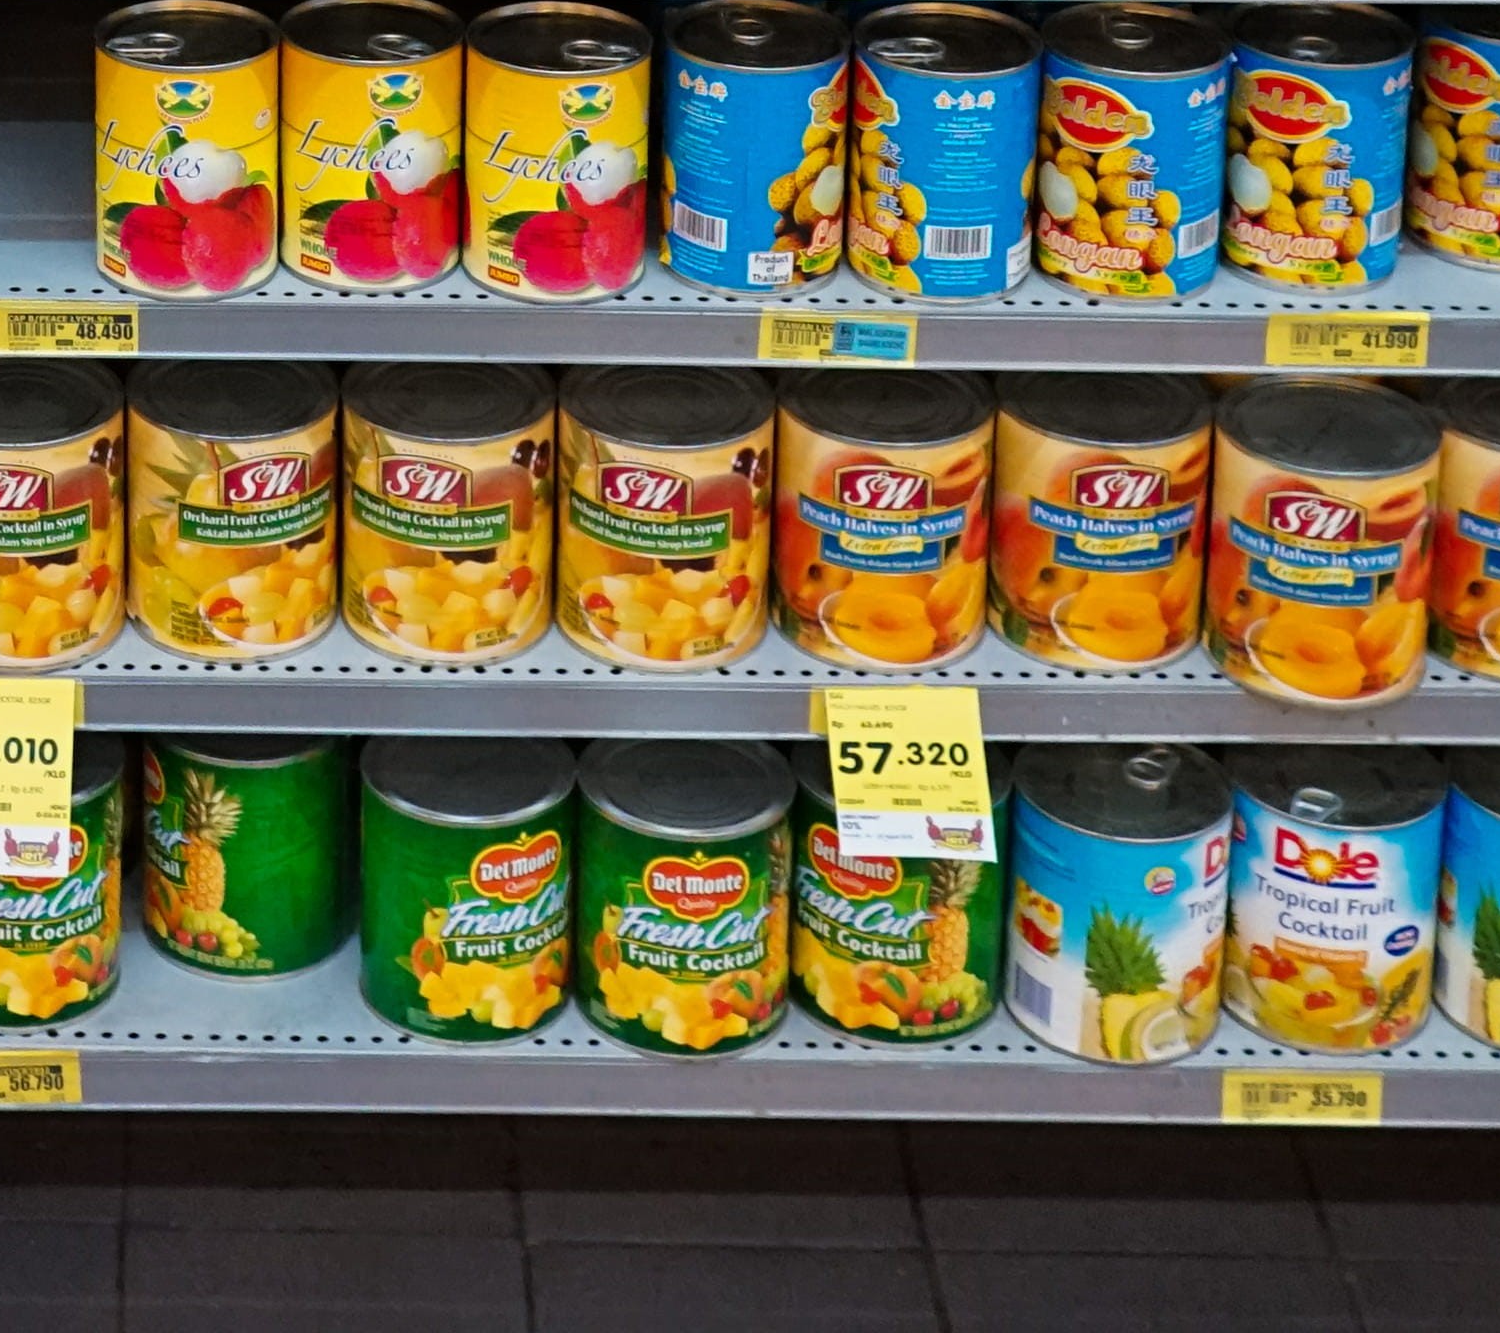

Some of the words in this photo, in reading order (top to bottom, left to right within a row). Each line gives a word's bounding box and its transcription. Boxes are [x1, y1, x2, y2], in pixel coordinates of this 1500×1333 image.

[296, 118, 415, 190] Lychees
[753, 251, 789, 264] Product
[76, 323, 133, 341] 48.490
[838, 741, 969, 775] 57.320
[1273, 832, 1379, 871] Dole
[653, 875, 680, 893] Del
[686, 875, 742, 894] Monte
[1255, 880, 1339, 915] Tropical
[1348, 897, 1394, 914] Fruit
[620, 905, 701, 944] Fresh
[703, 906, 773, 944] Cut
[1279, 913, 1367, 940] Cocktail
[629, 946, 677, 966] Fruit
[687, 943, 763, 968] Cocktail
[9, 1073, 65, 1092] 56.790
